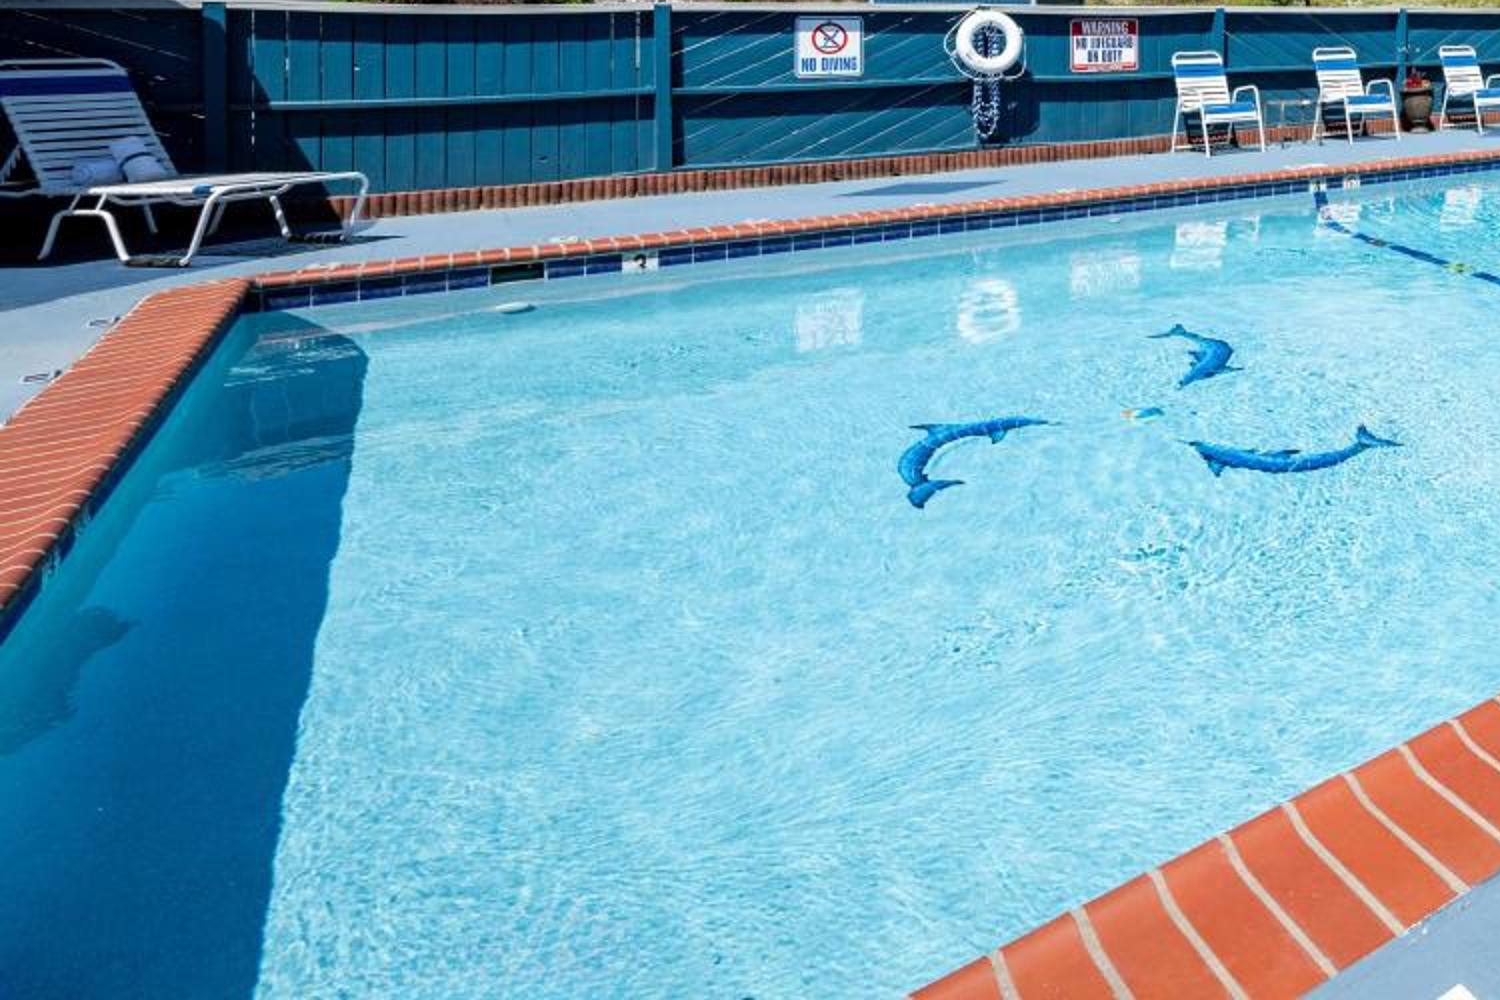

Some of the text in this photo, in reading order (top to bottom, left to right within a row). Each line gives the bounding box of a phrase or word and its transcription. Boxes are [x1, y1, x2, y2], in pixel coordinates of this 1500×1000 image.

[1081, 20, 1129, 34] WARNING
[1076, 37, 1133, 50] NO LIFEGUARD
[1087, 50, 1122, 62] ON DUTY
[801, 56, 858, 73] NO DIVING
